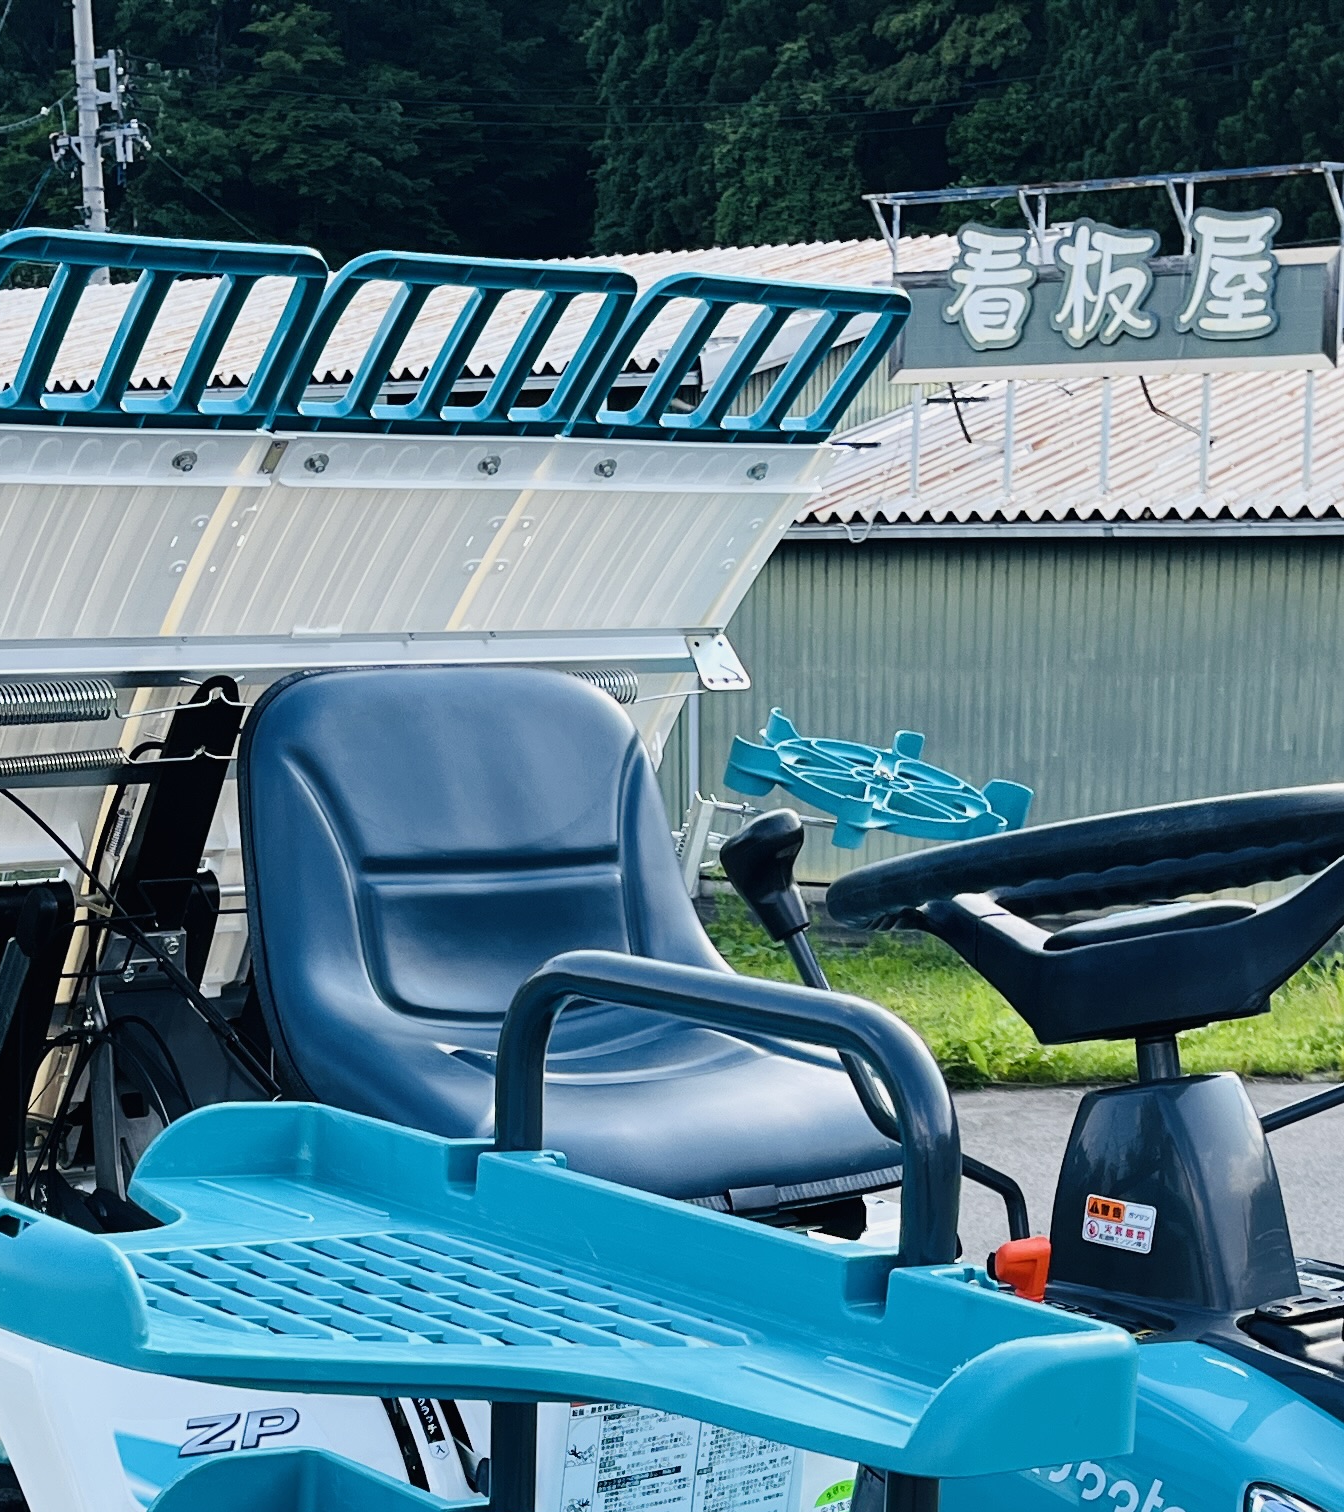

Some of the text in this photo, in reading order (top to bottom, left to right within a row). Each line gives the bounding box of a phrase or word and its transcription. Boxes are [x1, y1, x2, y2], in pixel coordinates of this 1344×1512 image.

[943, 213, 1277, 344] 看板屋
[178, 1407, 300, 1458] ZP
